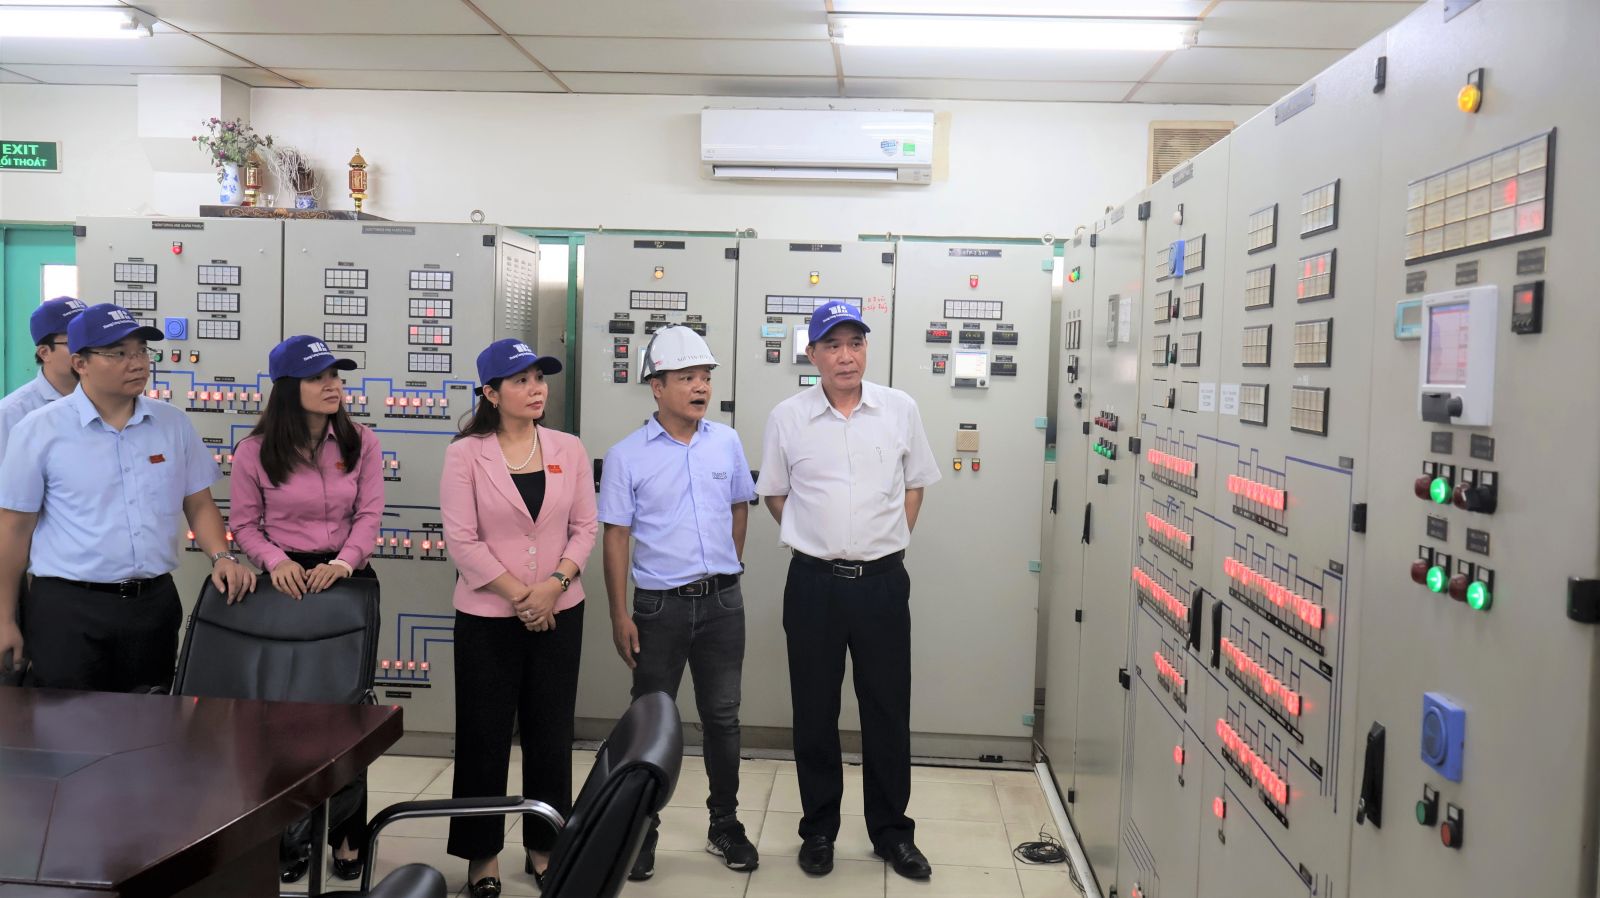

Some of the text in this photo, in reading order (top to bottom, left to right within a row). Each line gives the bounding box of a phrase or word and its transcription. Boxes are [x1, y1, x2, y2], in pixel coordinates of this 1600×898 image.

[2, 143, 39, 155] EXIT
[0, 155, 48, 167] ỐI THOÁT
